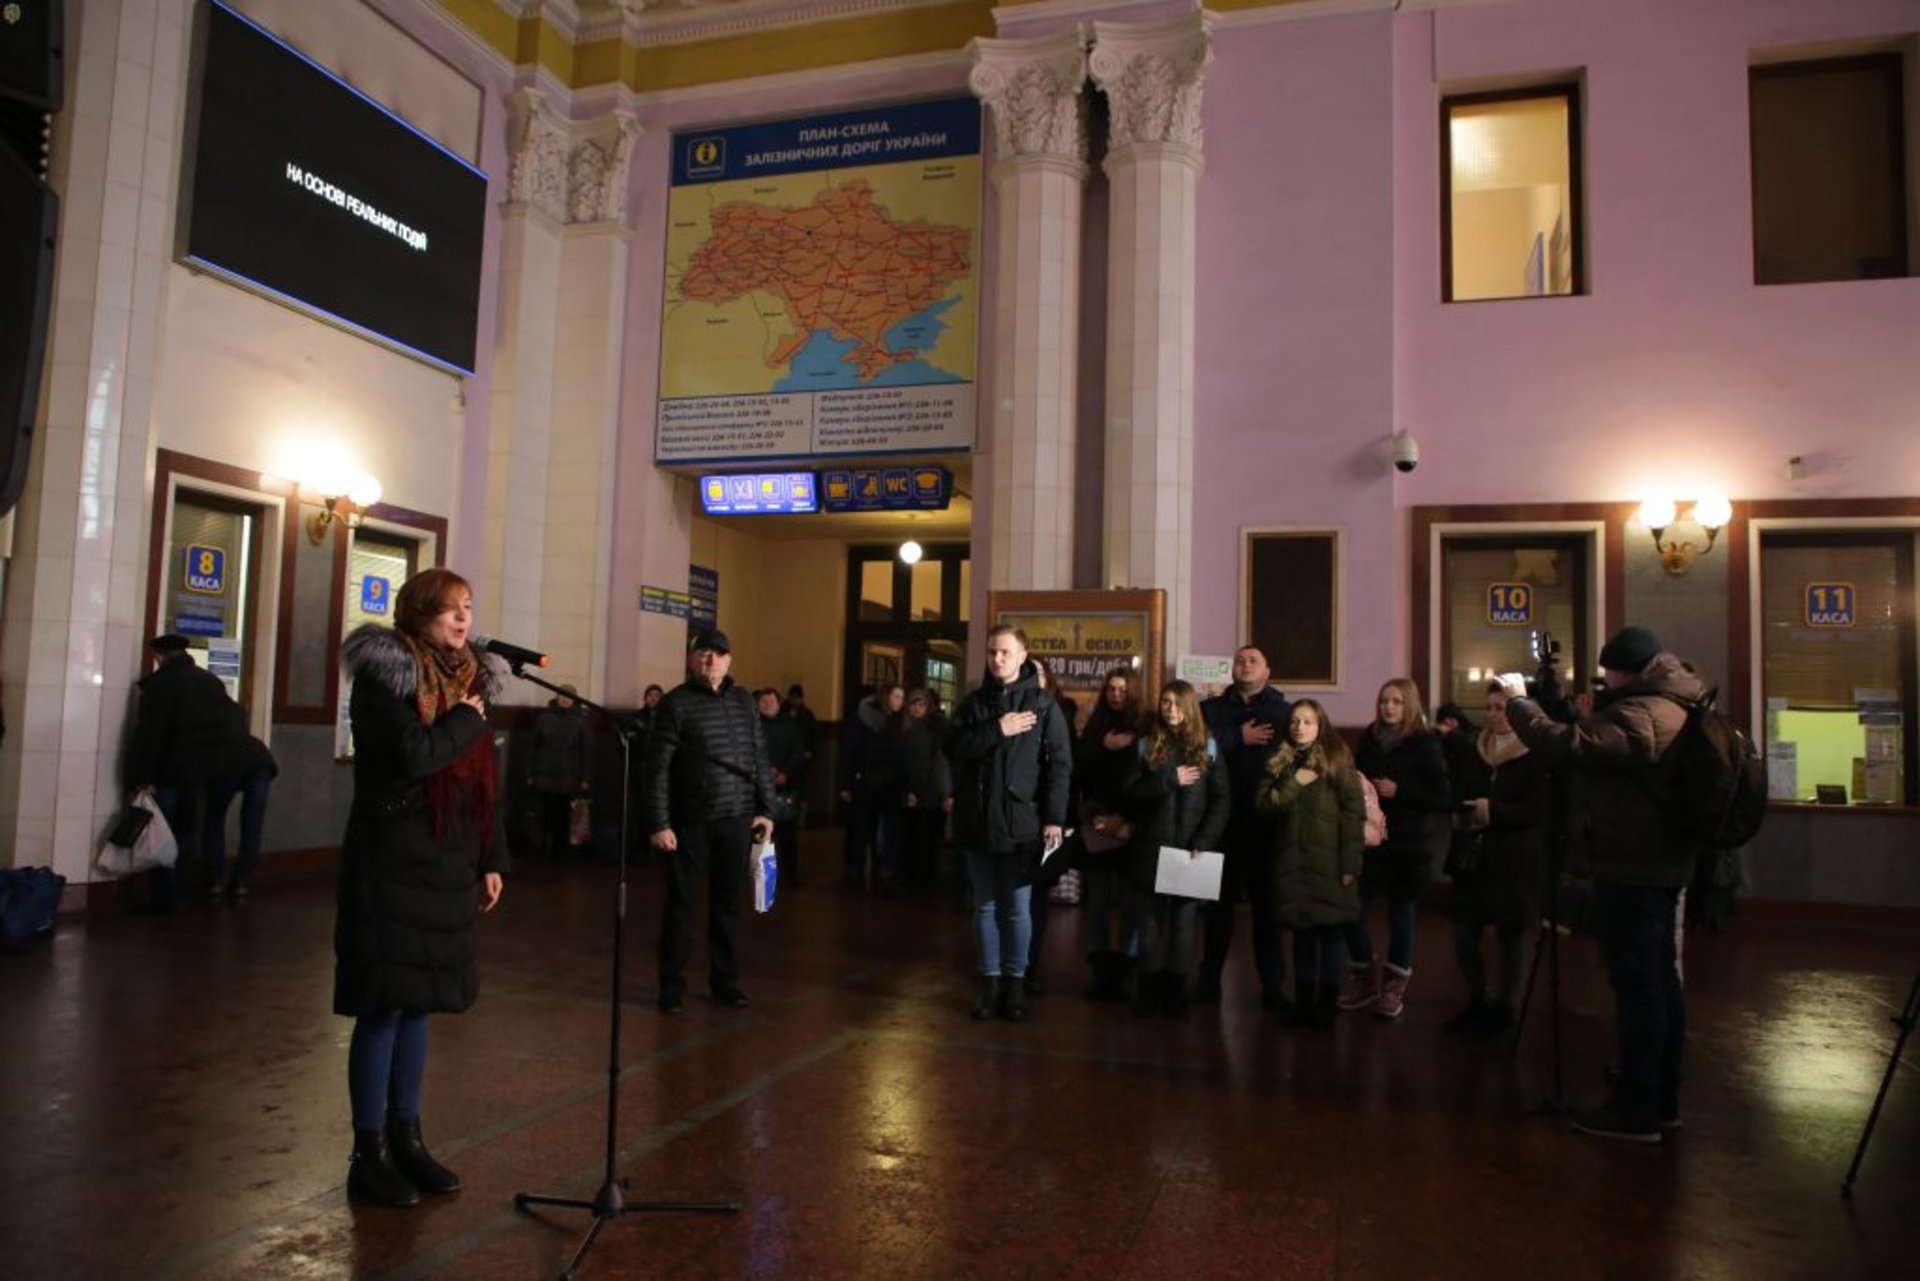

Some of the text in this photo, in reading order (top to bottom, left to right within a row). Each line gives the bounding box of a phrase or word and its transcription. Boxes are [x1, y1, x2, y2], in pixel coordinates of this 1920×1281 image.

[800, 121, 890, 142] ПЛАН-СХЕМА
[744, 133, 947, 166] ЗАЛІЗНИЧНИХ ДОРІГ УКРАЇНИ
[286, 162, 427, 252] НА ОСНОВІ РЕАЛЬНИХ ПОДІЙ
[886, 477, 908, 493] WC
[199, 551, 215, 575] 8
[190, 575, 220, 589] КАСА
[371, 580, 383, 600] 9
[1494, 588, 1527, 609] 10
[1813, 588, 1846, 611] 11
[1493, 610, 1527, 622] КАСА
[1811, 612, 1850, 624] КАСА
[1026, 637, 1132, 650] СТЕЛ ОСКАР
